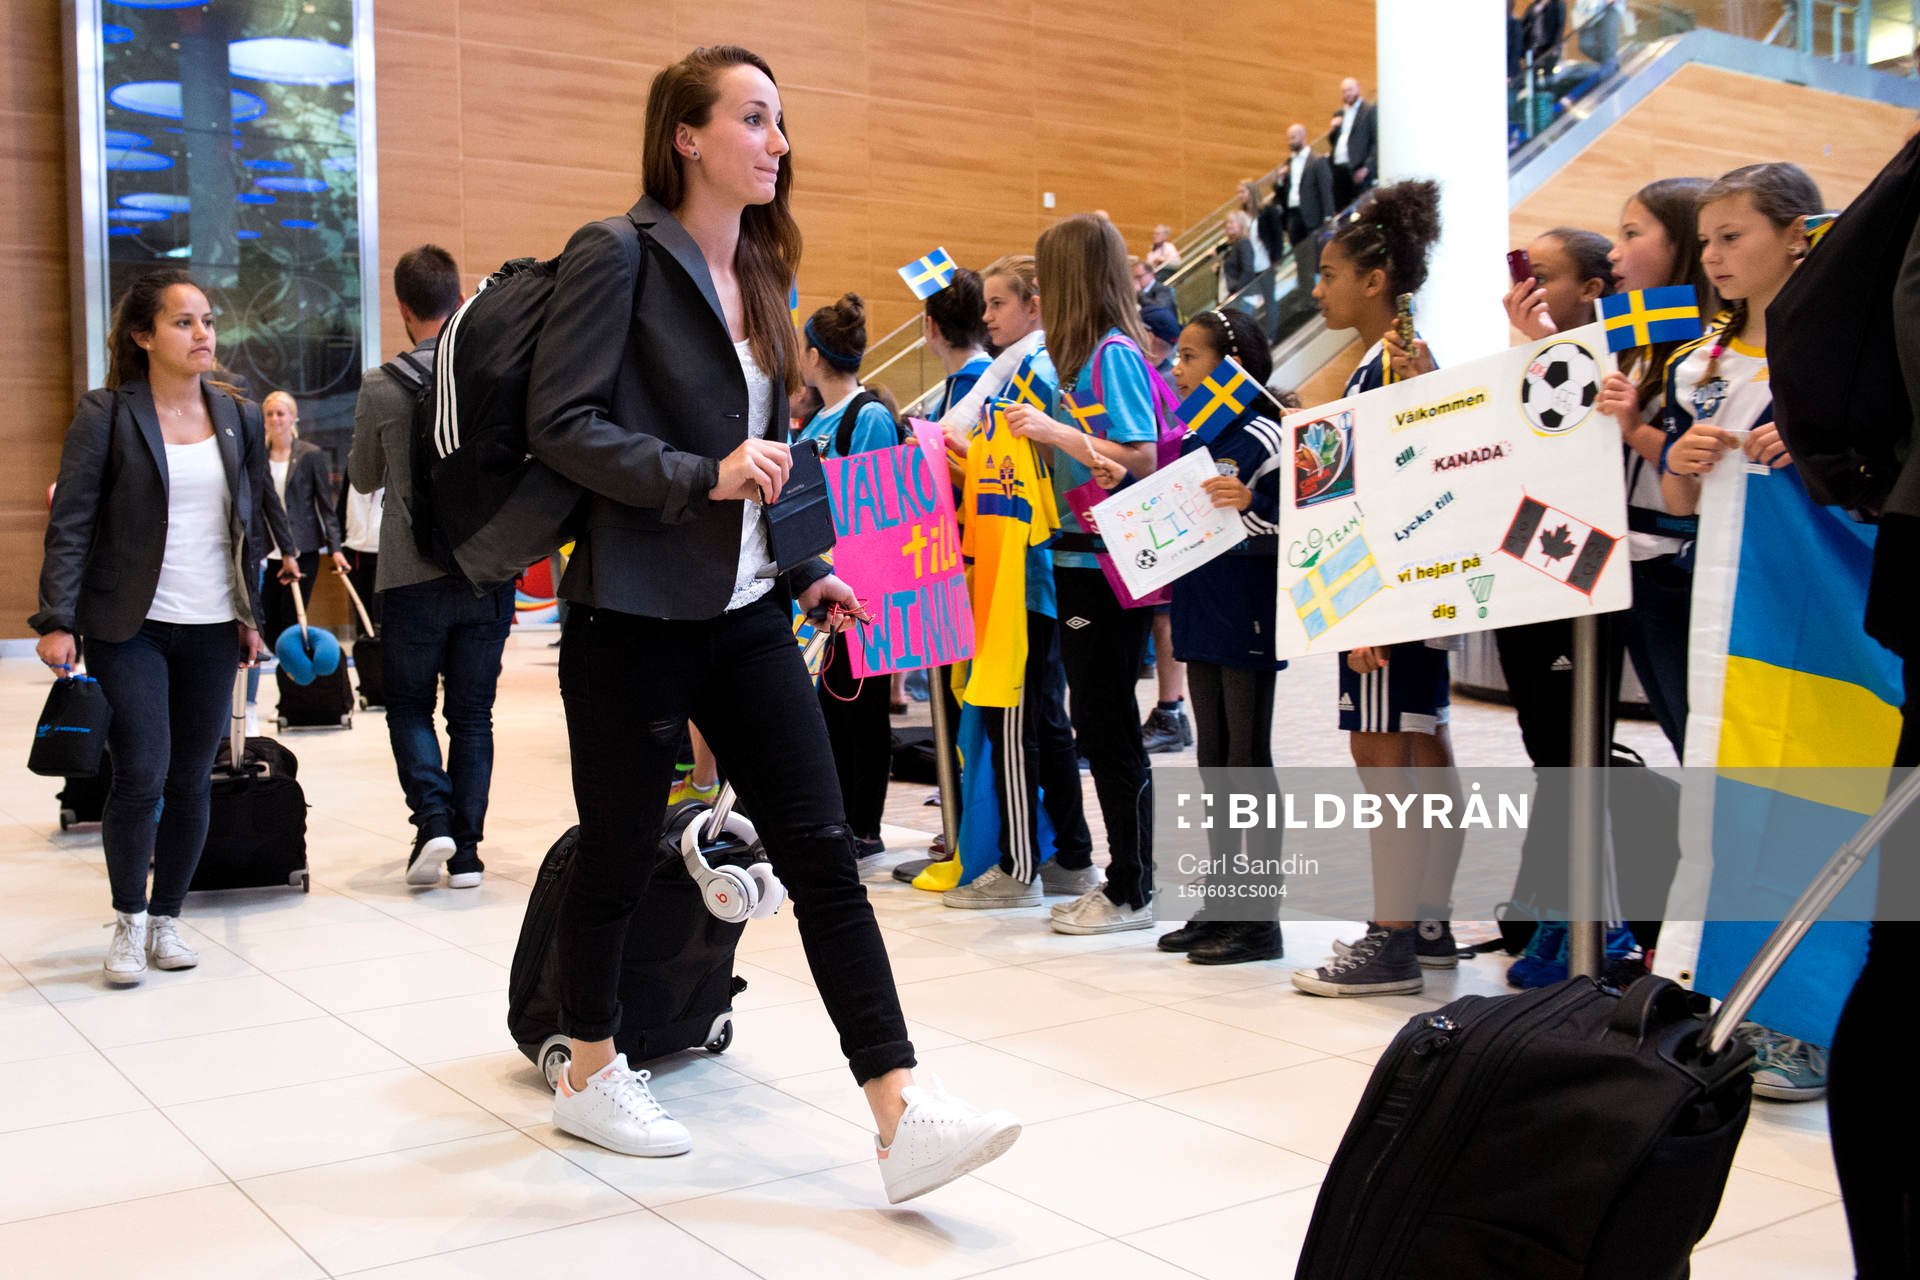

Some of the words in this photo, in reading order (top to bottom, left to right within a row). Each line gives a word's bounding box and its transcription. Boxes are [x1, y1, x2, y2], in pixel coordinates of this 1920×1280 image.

[1395, 393, 1485, 426] Välkommen
[1434, 444, 1504, 472] KANADA
[1394, 509, 1434, 542] Lycka
[1435, 491, 1454, 510] till
[1397, 569, 1412, 583] vi
[1416, 562, 1456, 579] hejar
[1461, 553, 1481, 573] på
[1432, 604, 1457, 619] dig
